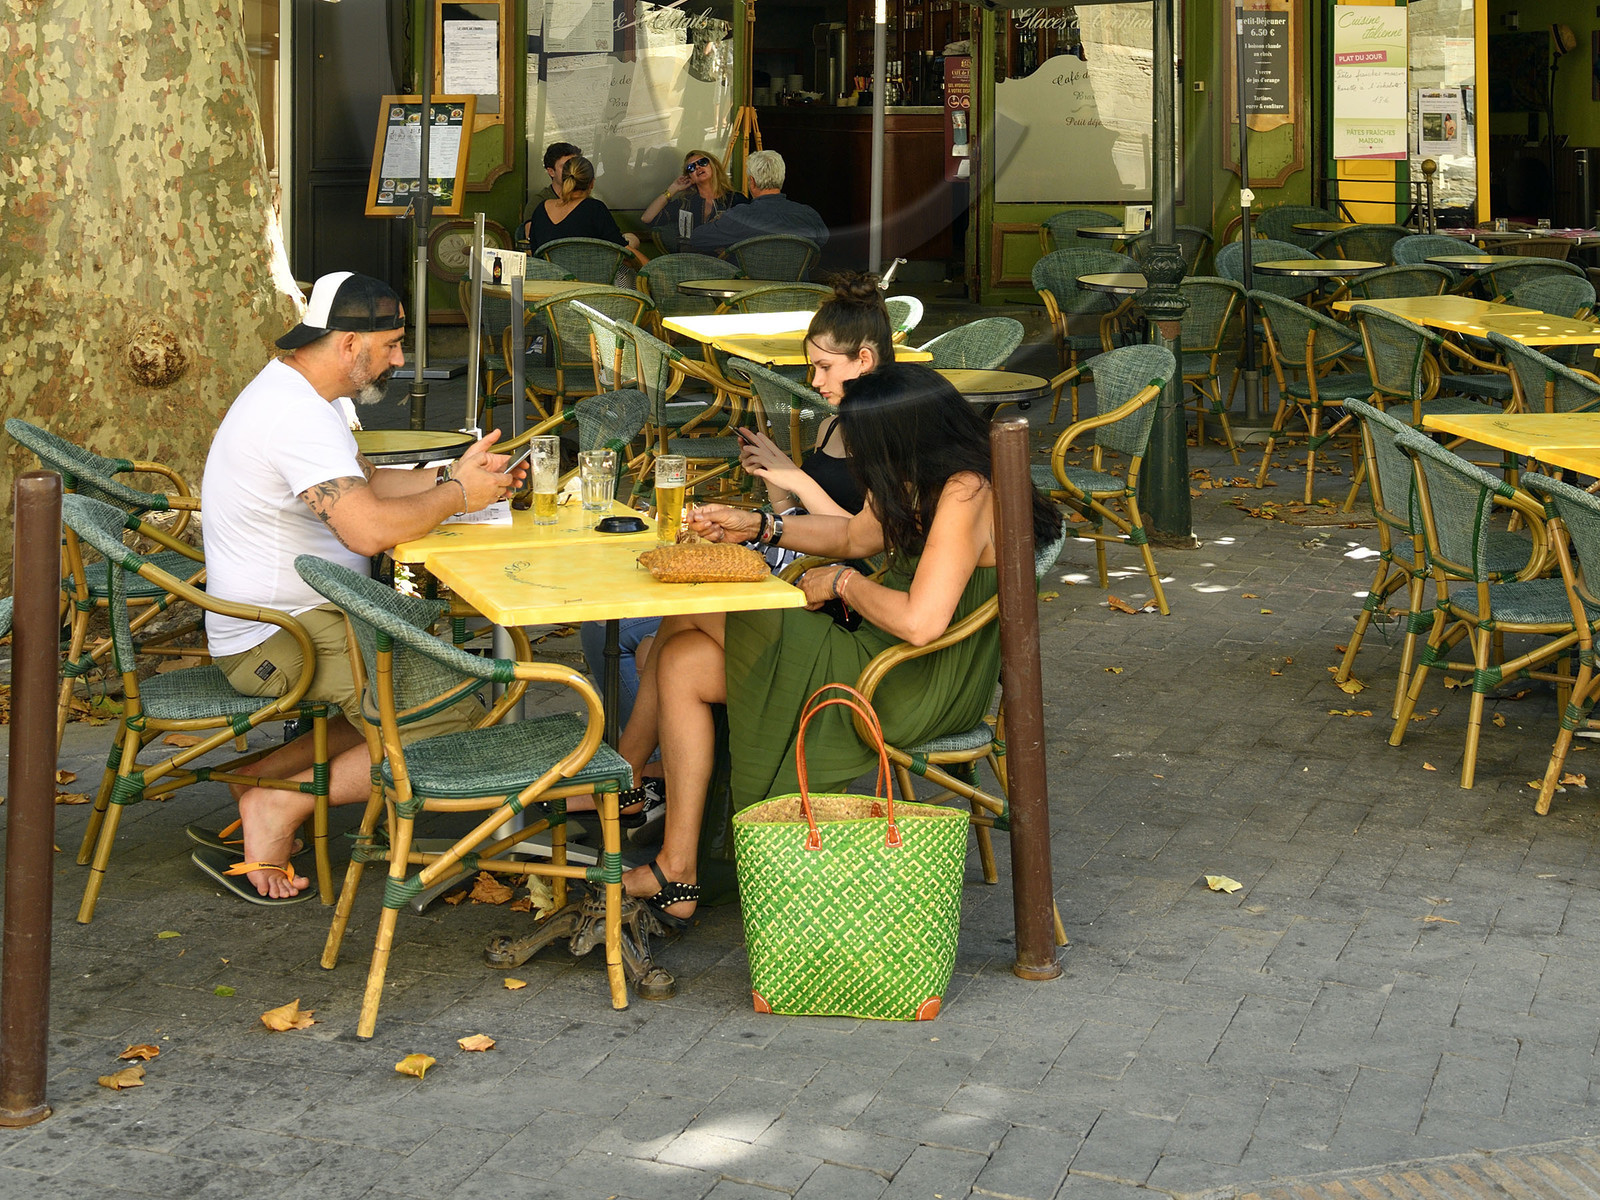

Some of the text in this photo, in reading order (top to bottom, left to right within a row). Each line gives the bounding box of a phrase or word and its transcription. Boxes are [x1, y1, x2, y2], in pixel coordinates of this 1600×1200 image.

[1014, 7, 1068, 30] Glaces
[1243, 17, 1286, 26] etit-Déjeuner
[1338, 11, 1380, 28] Cuisine
[1250, 28, 1275, 36] 6.50 €
[1362, 21, 1403, 39] italienne
[1366, 53, 1383, 61] JOUR
[1051, 70, 1080, 87] Café
[1064, 116, 1087, 127] Petit
[1346, 128, 1396, 136] PÂTES FRAÎCHES
